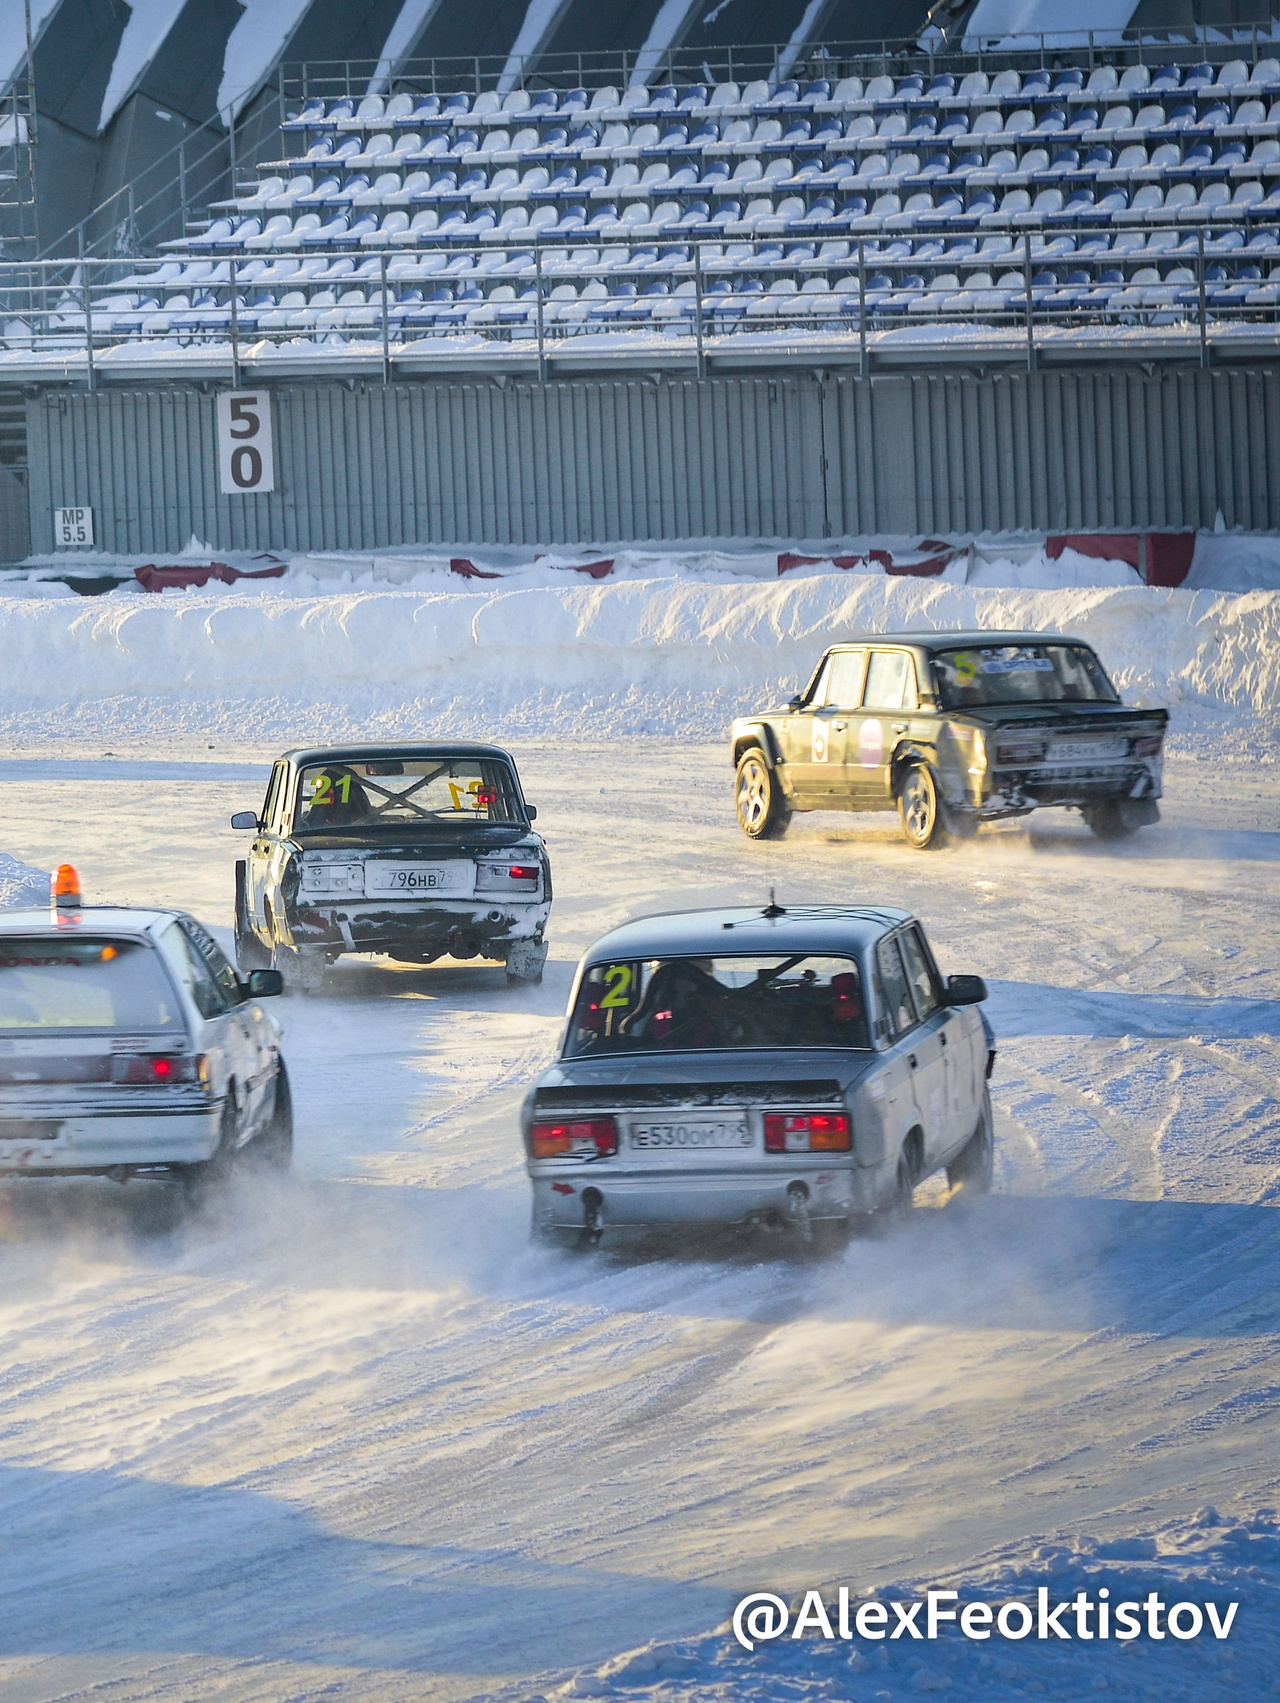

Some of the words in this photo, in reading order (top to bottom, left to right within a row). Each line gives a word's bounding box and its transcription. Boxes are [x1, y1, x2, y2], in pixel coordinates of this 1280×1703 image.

[62, 526, 86, 543] 5.5
[309, 774, 352, 805] 21
[600, 966, 633, 1009] 2
